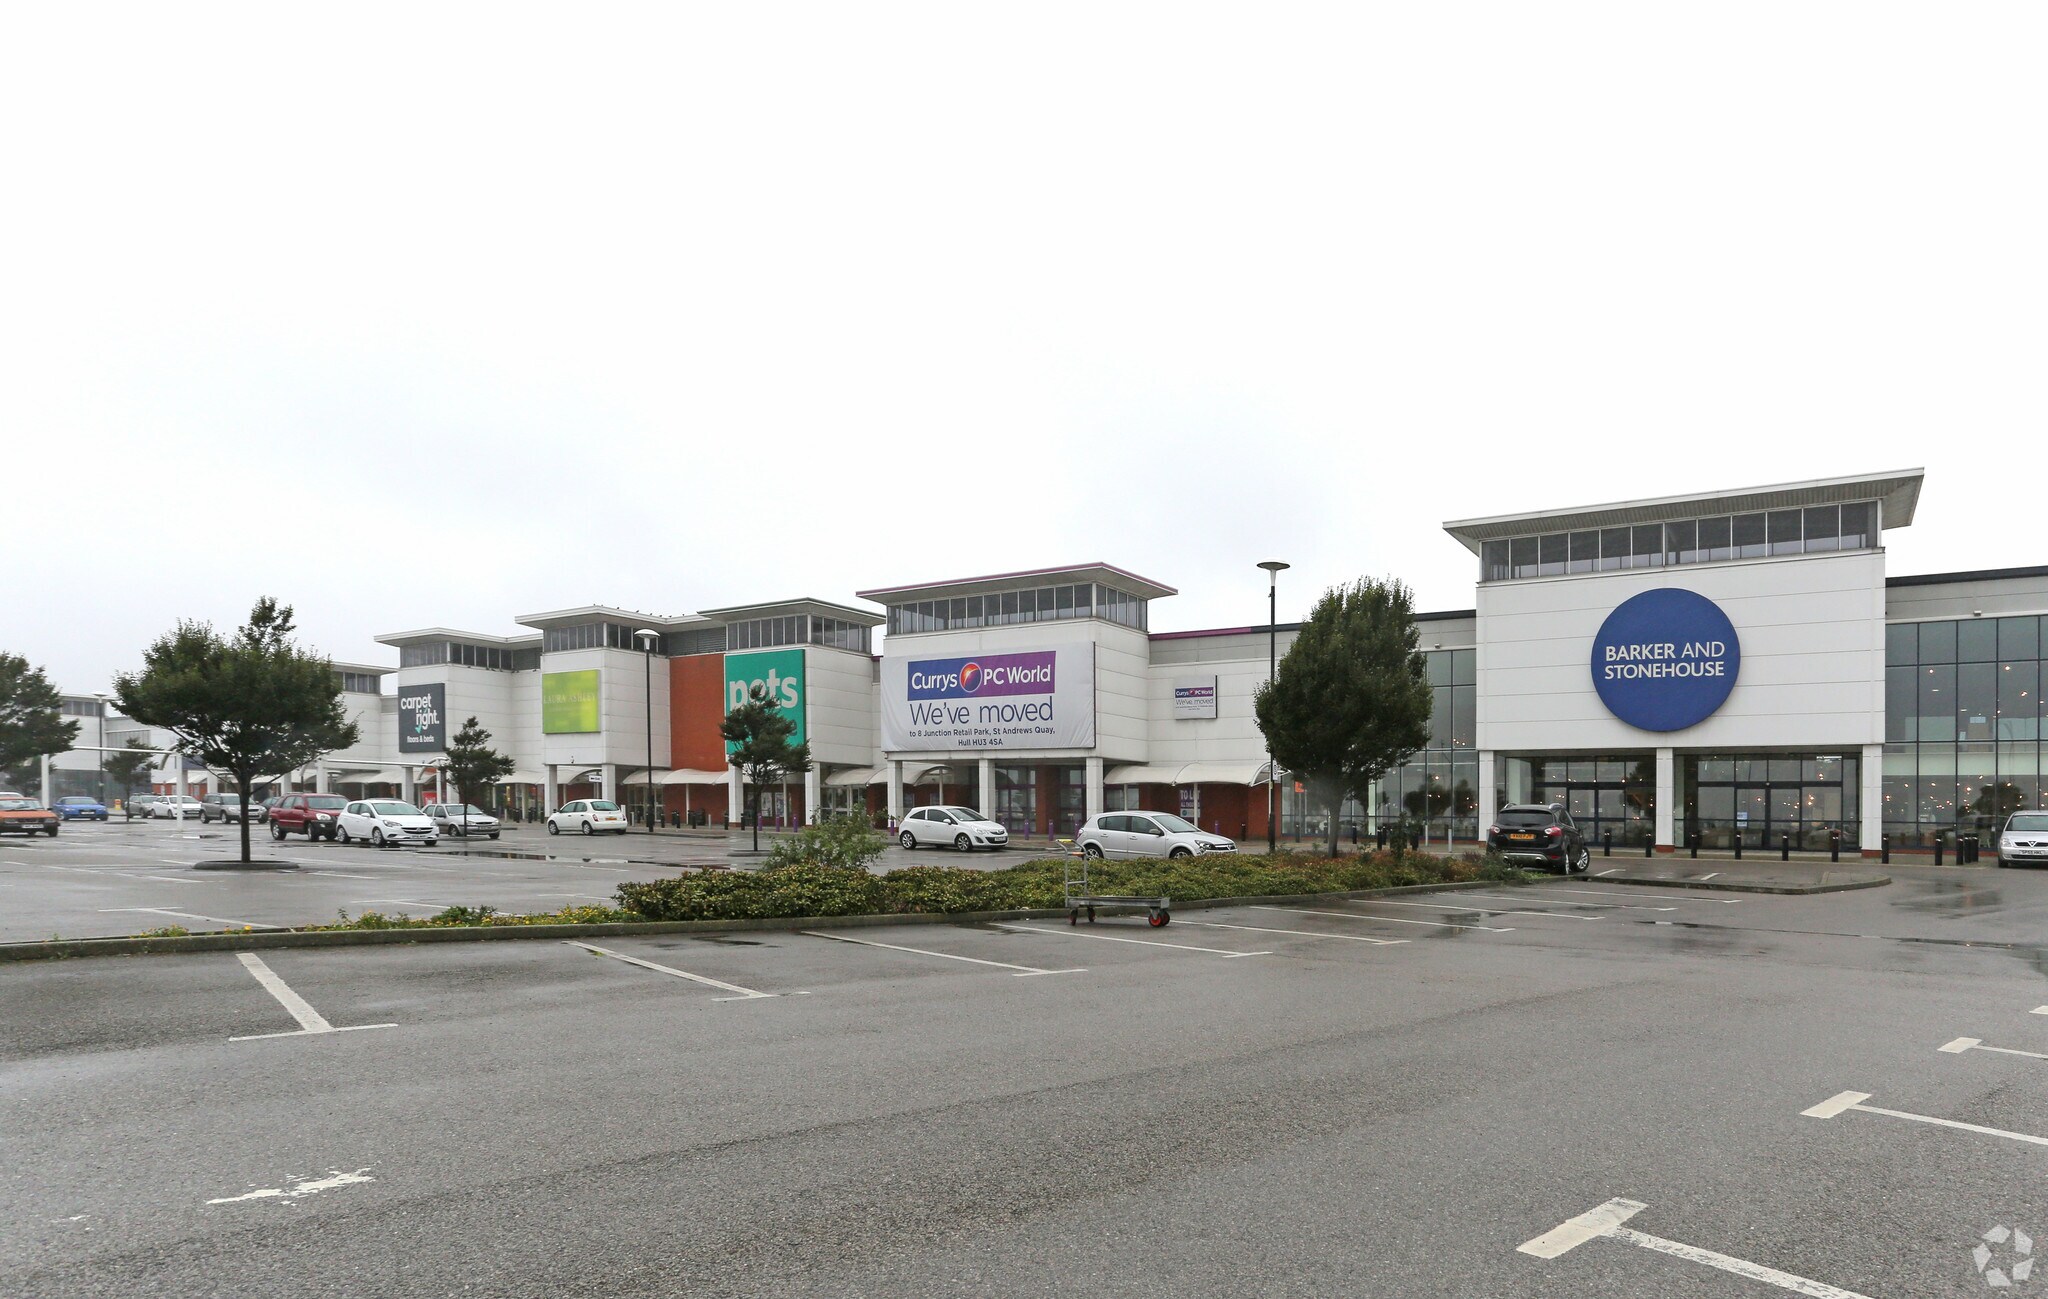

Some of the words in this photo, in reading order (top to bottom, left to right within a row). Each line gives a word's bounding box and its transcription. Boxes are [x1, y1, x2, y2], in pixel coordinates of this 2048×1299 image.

[1605, 643, 1676, 661] BARKER
[1681, 641, 1725, 659] AND
[911, 672, 958, 691] Currys
[983, 667, 1005, 686] PC
[1006, 664, 1051, 684] World
[1604, 661, 1725, 680] STONEHOUSE
[400, 693, 432, 713] carpet
[909, 701, 970, 726] We've
[979, 695, 1053, 723] moved
[923, 729, 952, 737] Junction
[953, 729, 973, 737] Retail
[973, 728, 991, 736] Park,
[1002, 727, 1033, 735] Andrews
[1034, 726, 1056, 735] Quay,
[958, 739, 971, 747] Hull
[1180, 790, 1189, 800] TO
